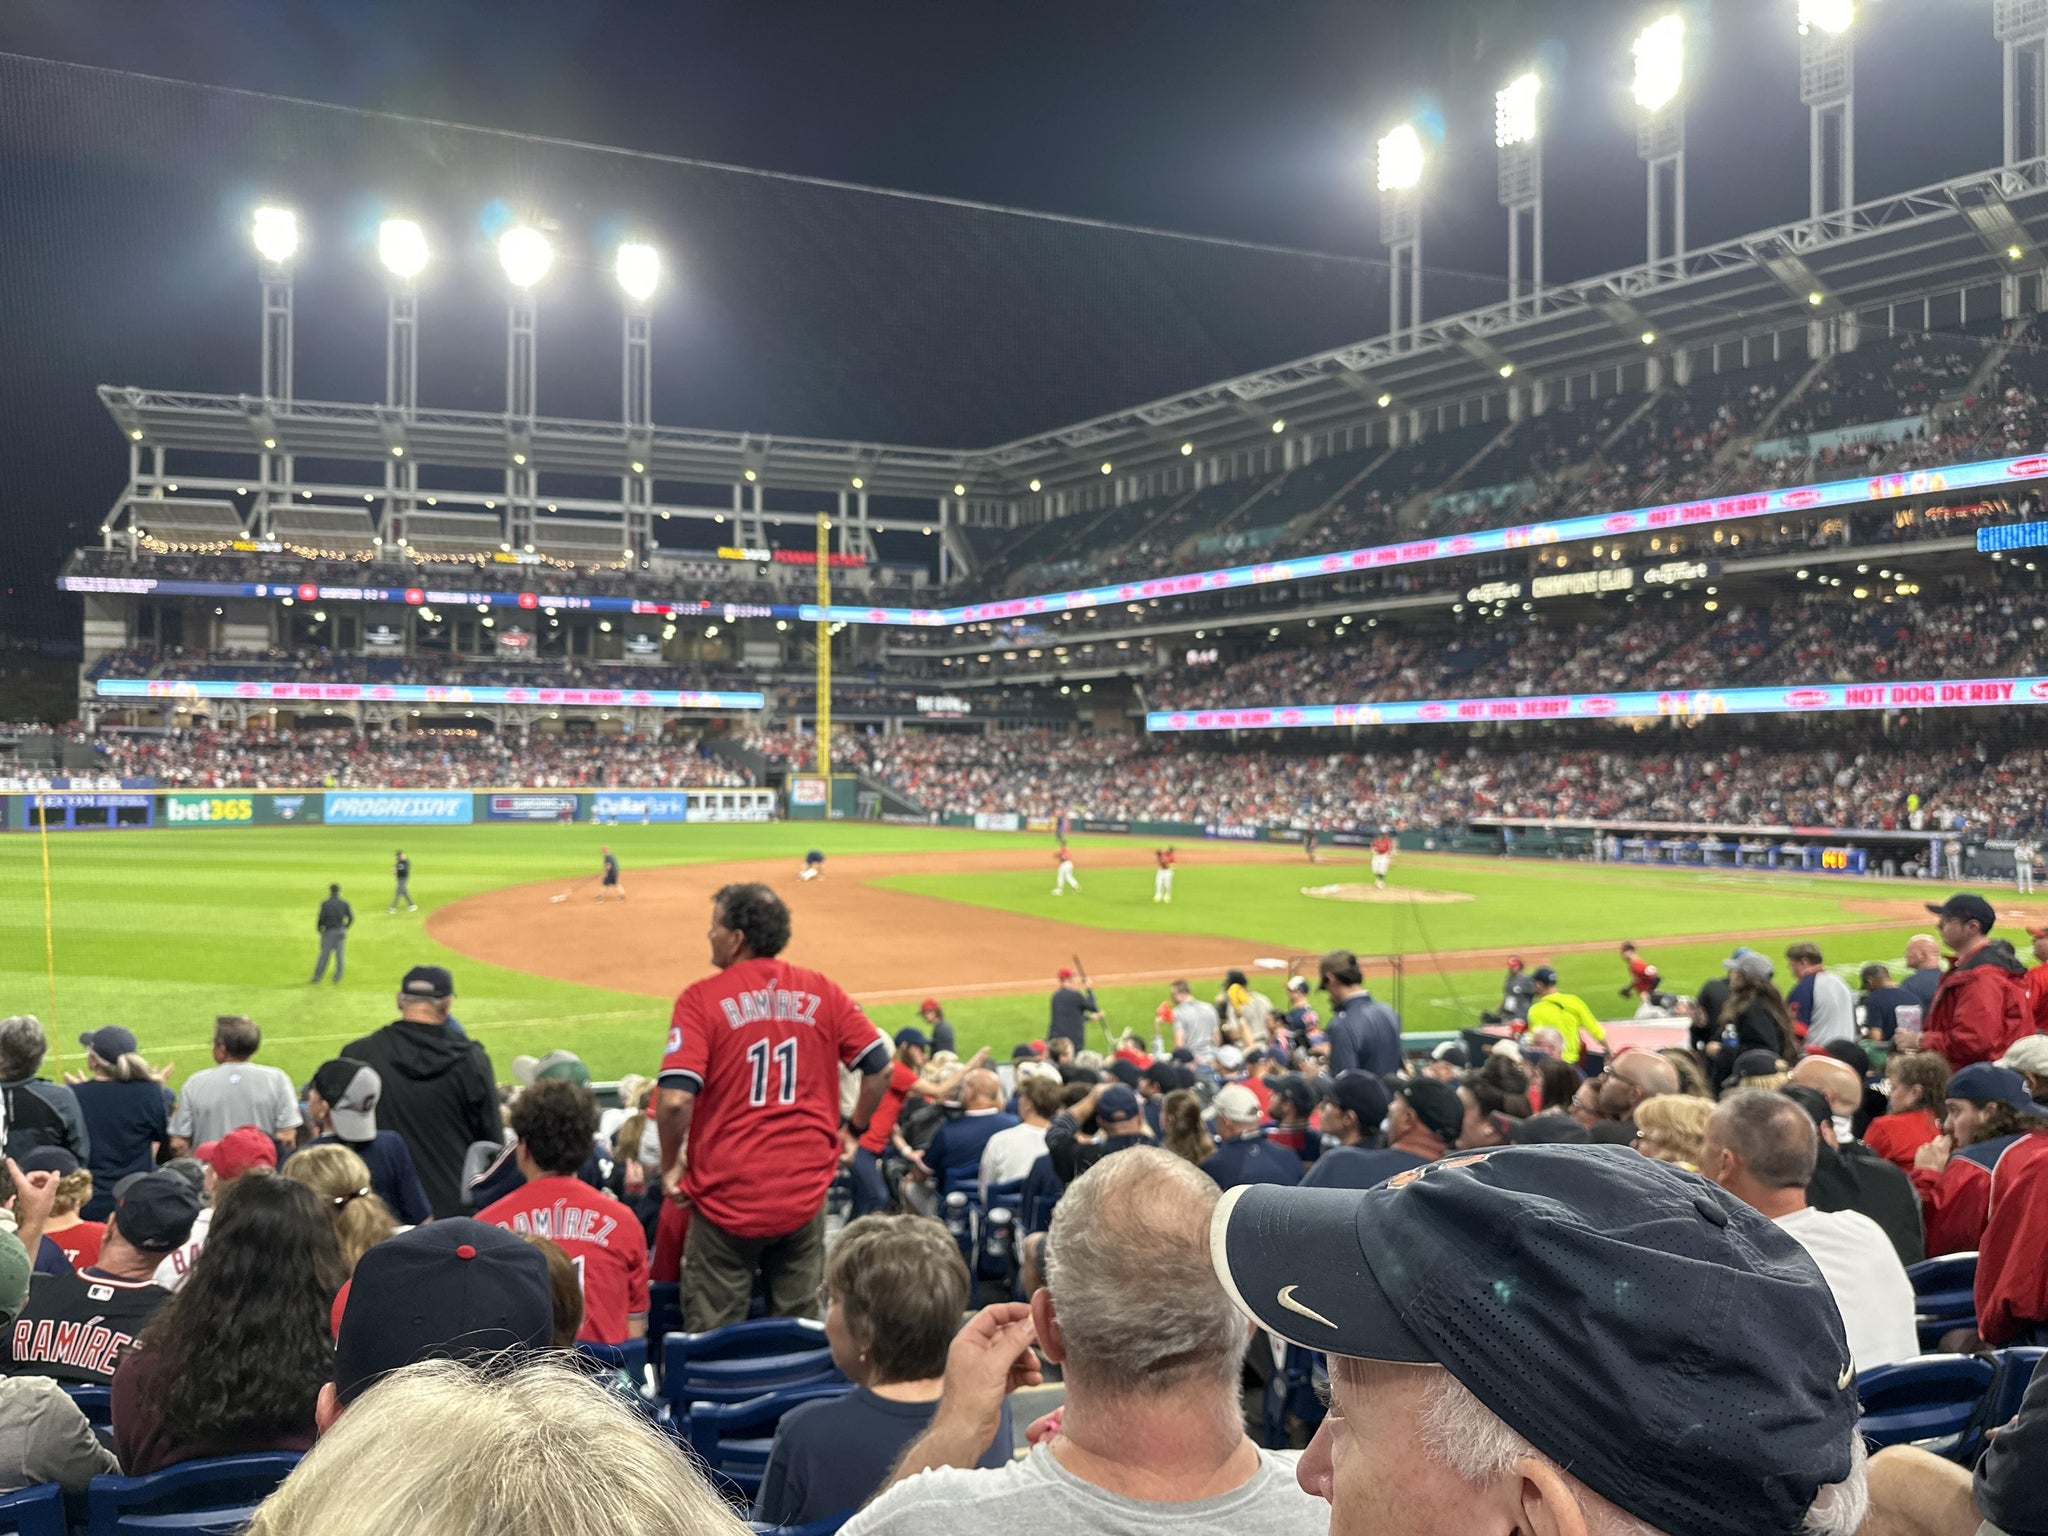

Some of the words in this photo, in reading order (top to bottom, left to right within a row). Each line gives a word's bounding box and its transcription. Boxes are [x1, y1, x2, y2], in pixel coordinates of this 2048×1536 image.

[1845, 686, 1885, 705] HOT
[1892, 685, 1935, 703] DOG
[1941, 682, 2015, 702] DERBY
[168, 798, 253, 821] bet365
[329, 797, 464, 817] PROGRESSIVE
[719, 978, 821, 1029] RAMÍREZ
[746, 1036, 797, 1107] 11
[13, 1315, 143, 1375] RAMÍRE
